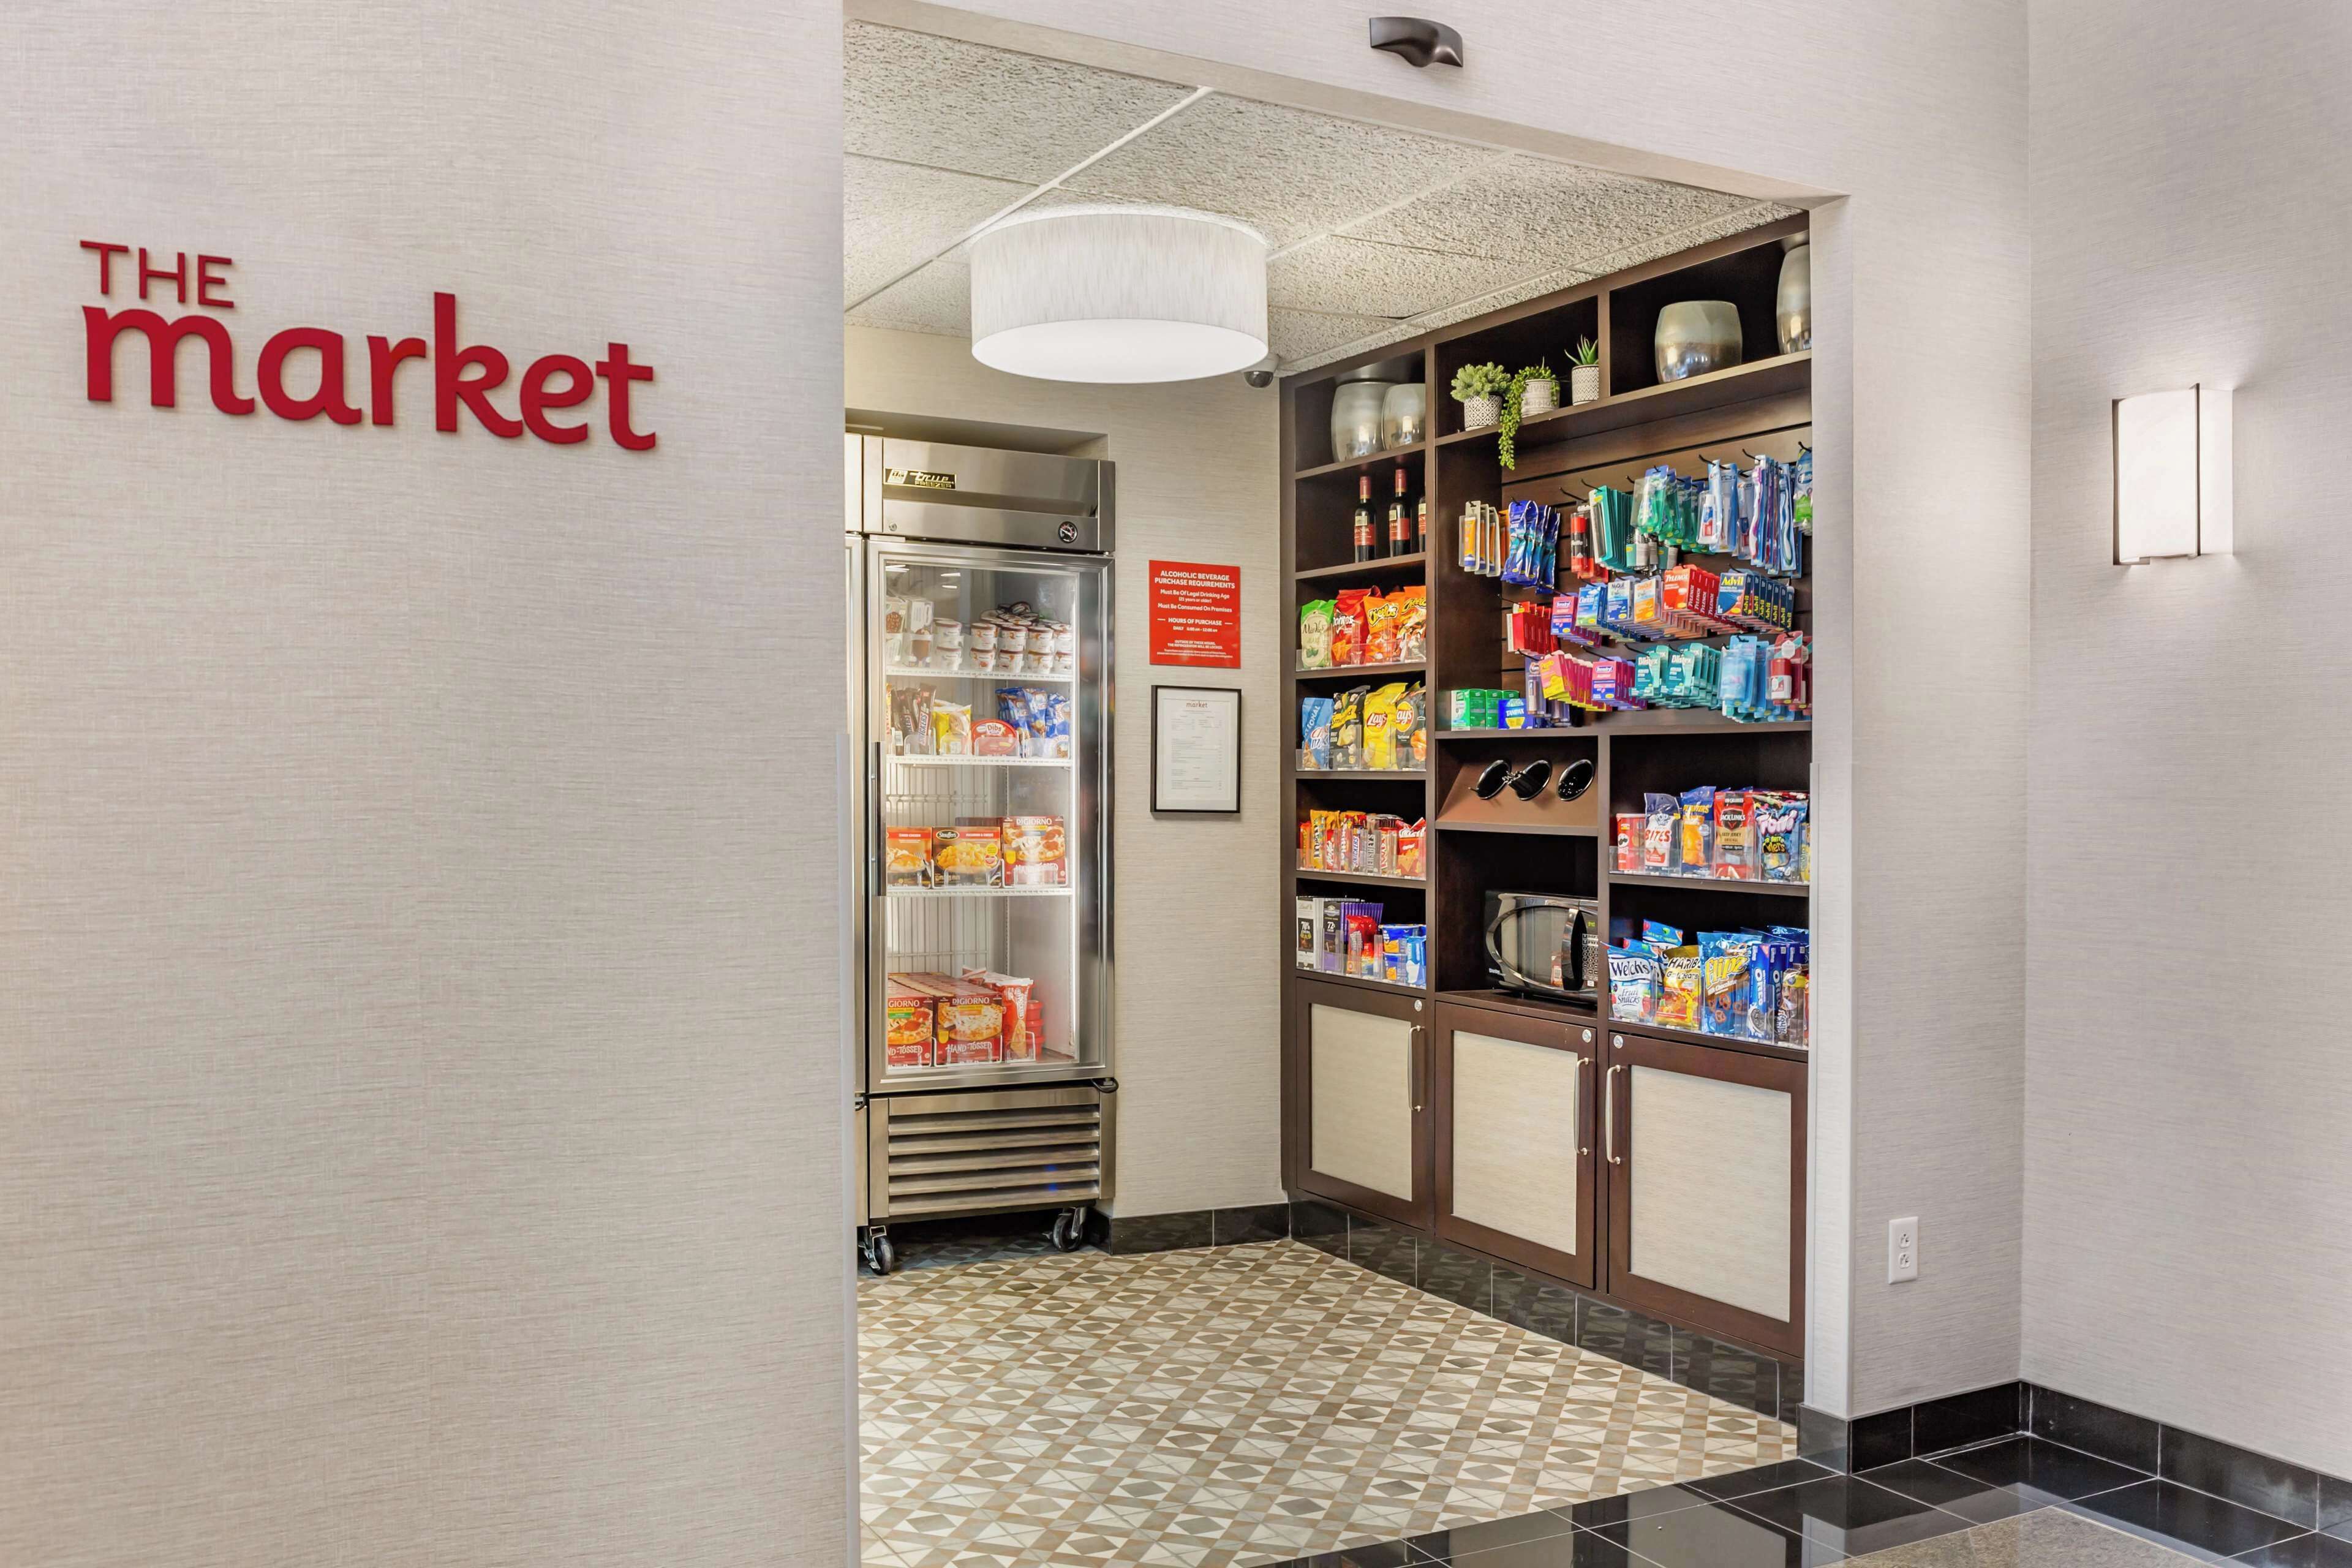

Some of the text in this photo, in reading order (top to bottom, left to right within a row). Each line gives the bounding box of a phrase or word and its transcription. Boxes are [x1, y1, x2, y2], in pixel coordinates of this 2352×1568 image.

[80, 240, 235, 309] THE
[81, 291, 657, 451] market
[1160, 570, 1230, 581] ALCOHOLIC BEVERAGE
[1721, 576, 1744, 586] Advil
[1154, 577, 1235, 589] PURCHASE REQUIREMENTS
[1506, 708, 1525, 717] TAMPAX
[987, 723, 1002, 731] Dibs
[1645, 829, 1671, 843] BITES
[1610, 960, 1650, 977] Welch's
[1754, 968, 1763, 1006] OREO
[888, 1000, 920, 1008] GIORNO
[952, 997, 990, 1006] DIGIORNO
[1617, 994, 1640, 1005] Snacks
[888, 1044, 924, 1056] ND-TOSSED
[945, 1041, 992, 1054] HAND-TOSSED
